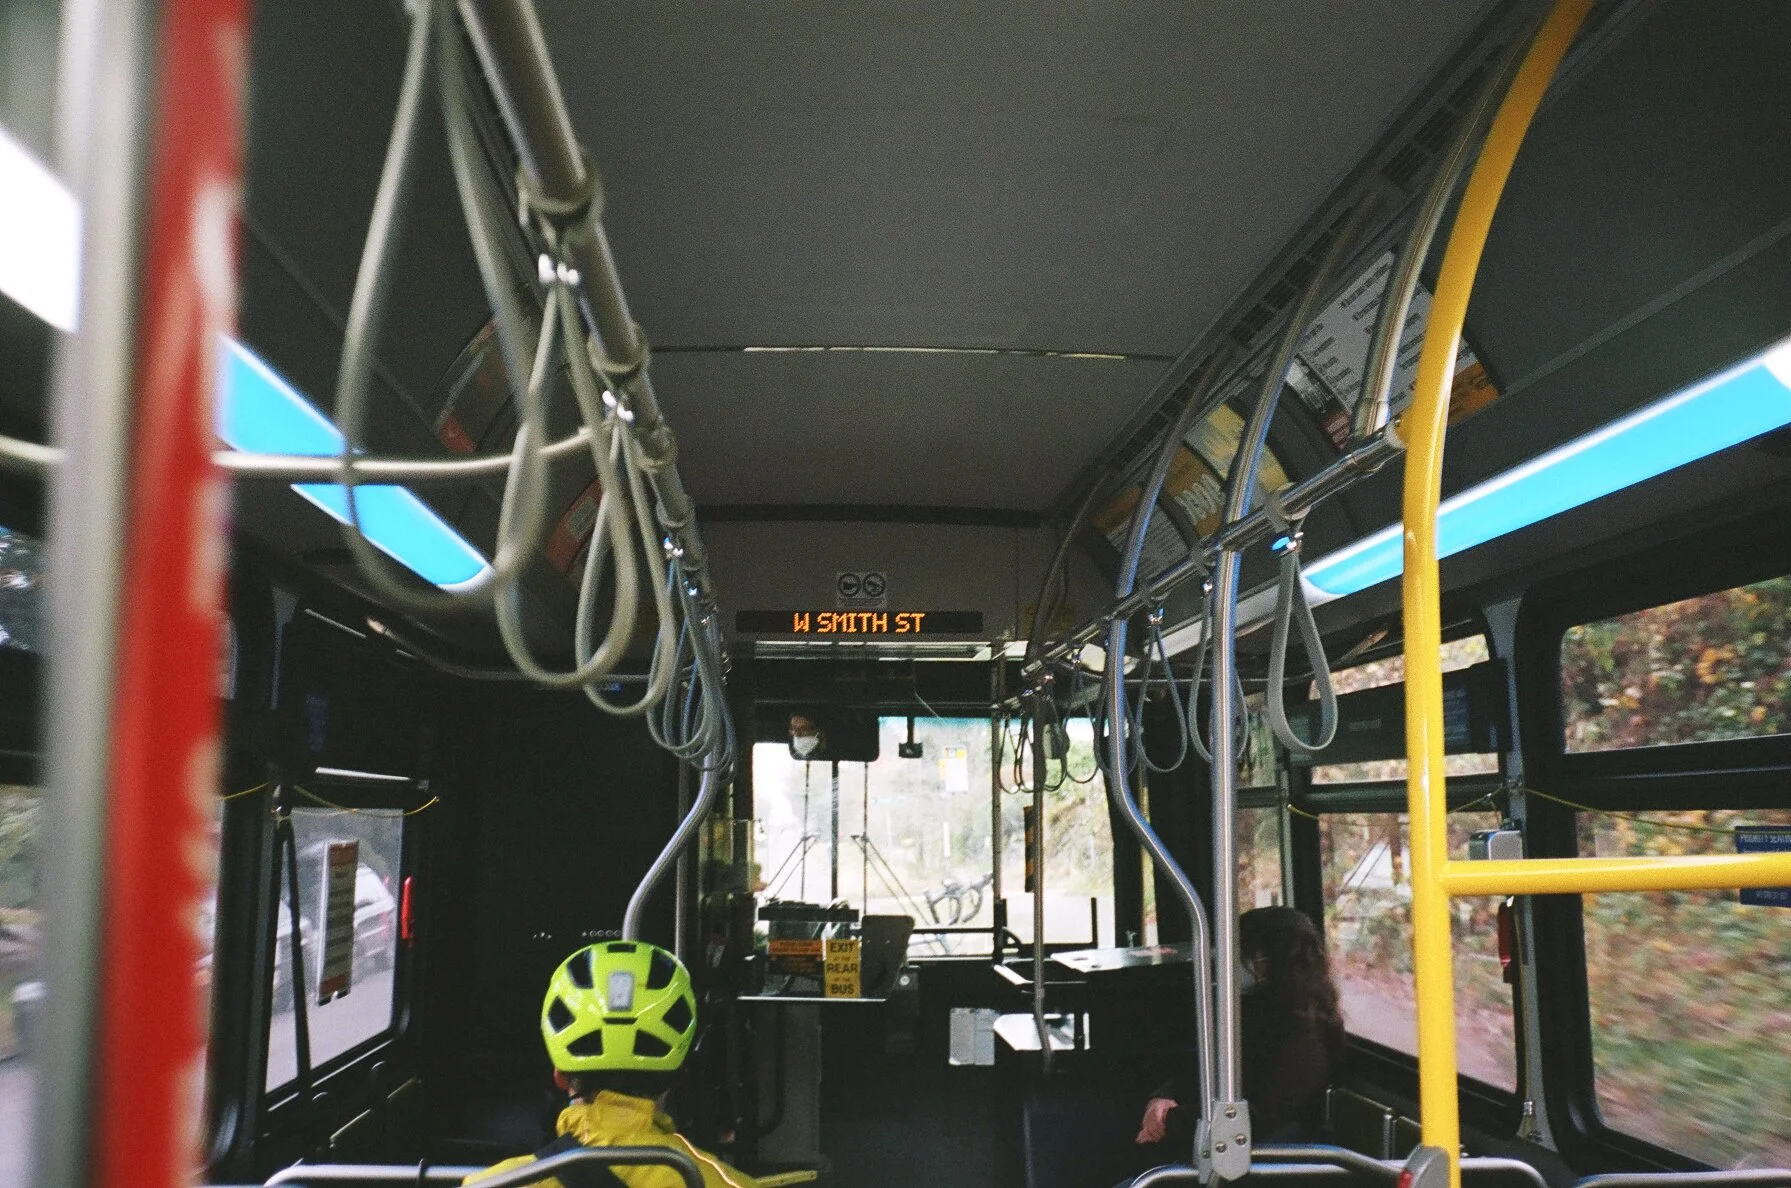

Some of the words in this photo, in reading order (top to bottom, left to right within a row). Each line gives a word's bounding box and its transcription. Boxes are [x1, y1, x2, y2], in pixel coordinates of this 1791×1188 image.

[793, 612, 810, 633] W
[816, 612, 888, 633] SMITH
[895, 612, 925, 633] ST
[830, 942, 853, 953] EXIT
[827, 963, 858, 974] REAR
[831, 984, 855, 994] BUS
